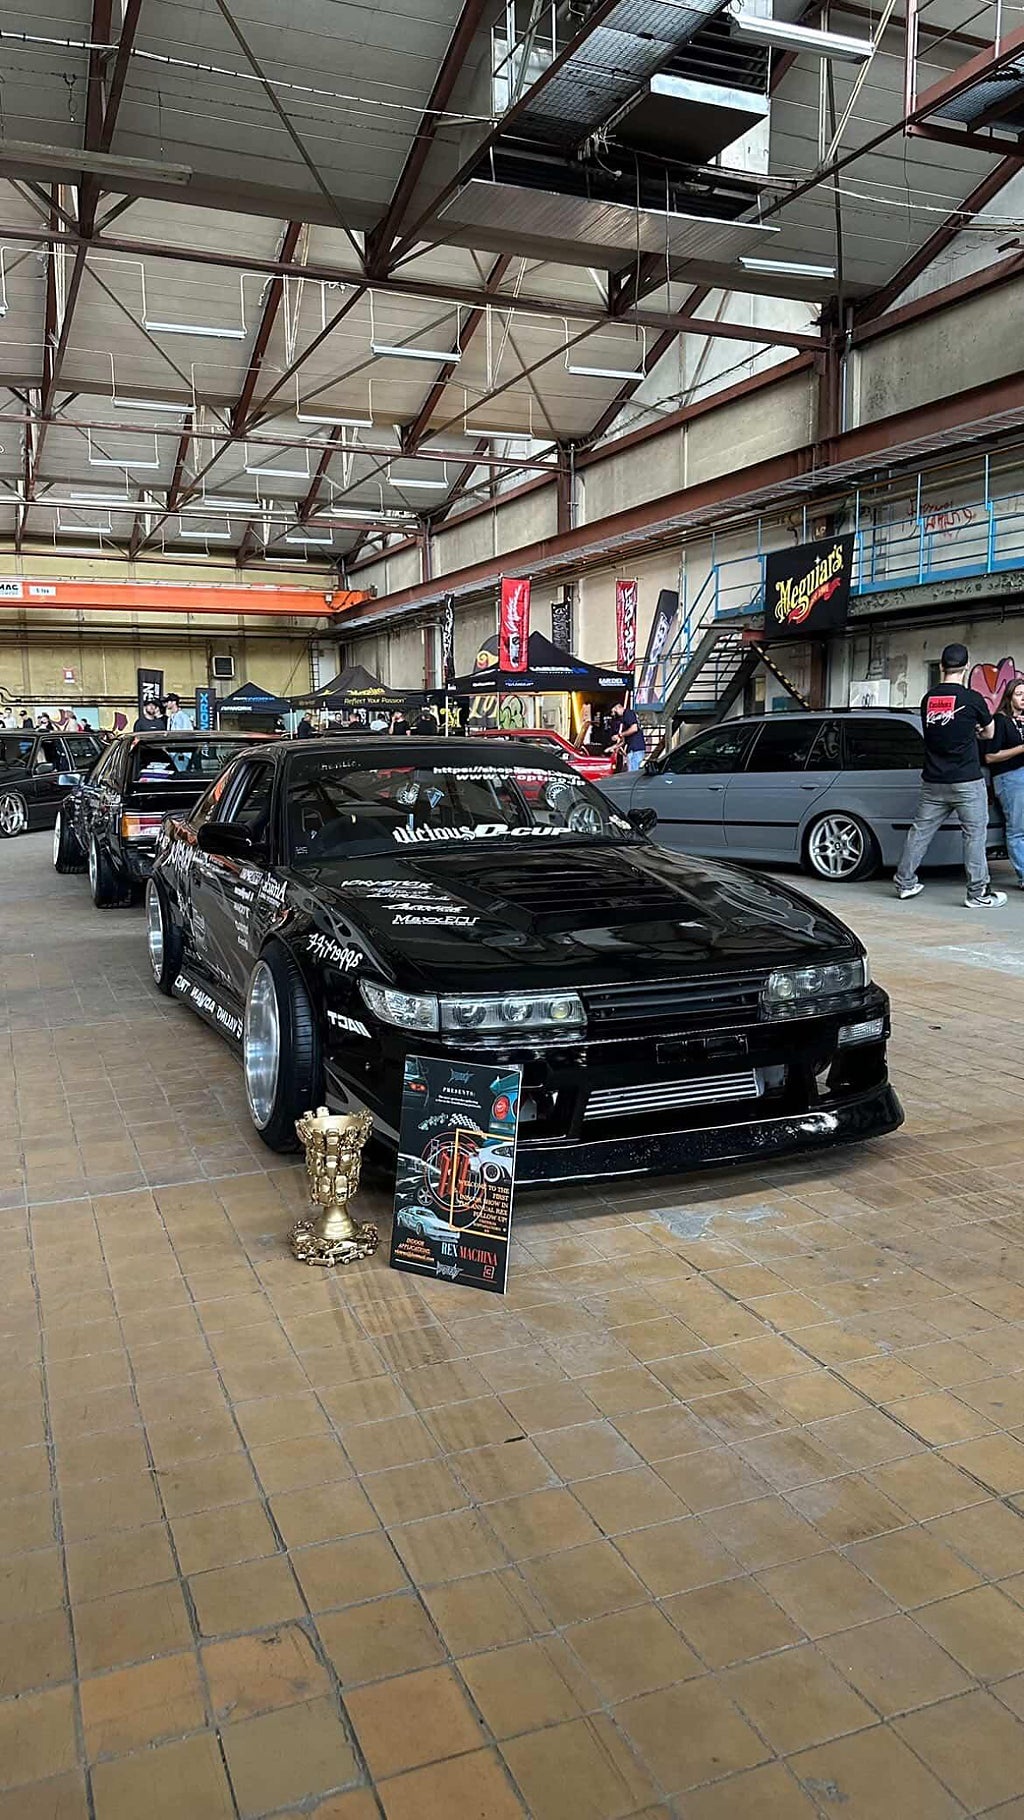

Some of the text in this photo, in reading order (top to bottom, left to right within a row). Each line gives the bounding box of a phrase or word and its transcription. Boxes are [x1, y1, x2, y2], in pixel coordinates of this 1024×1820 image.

[774, 544, 843, 623] Meguiar's
[392, 915, 480, 925] MaxxECU
[441, 1242, 458, 1257] REX
[460, 1245, 498, 1266] MACHINA
